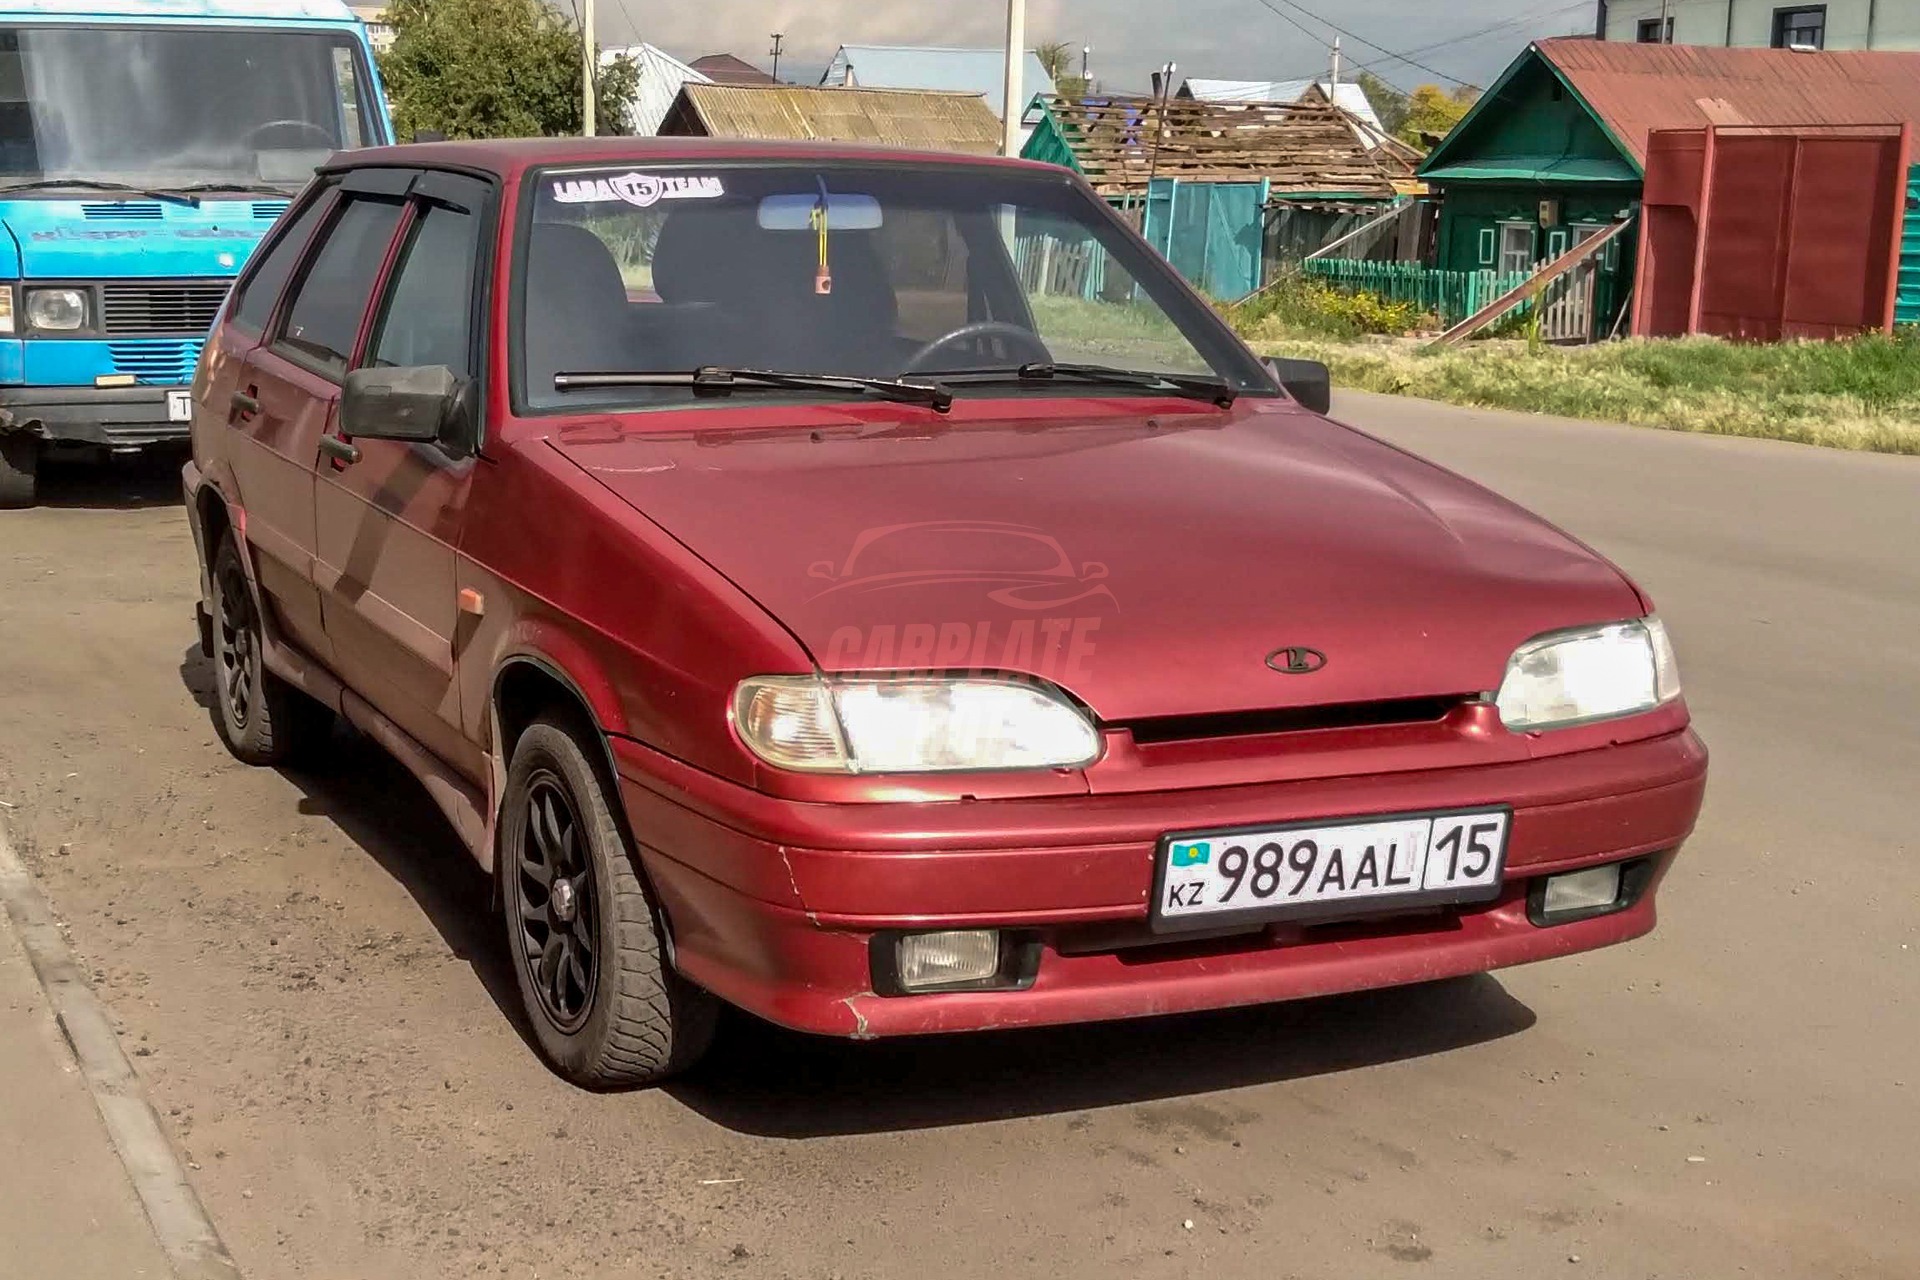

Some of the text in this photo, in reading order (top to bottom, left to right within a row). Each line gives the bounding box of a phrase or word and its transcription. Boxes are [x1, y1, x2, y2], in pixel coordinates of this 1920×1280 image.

[553, 177, 724, 202] LADA 15 TEAM
[1168, 822, 1498, 908] KZ 989AAL 15
